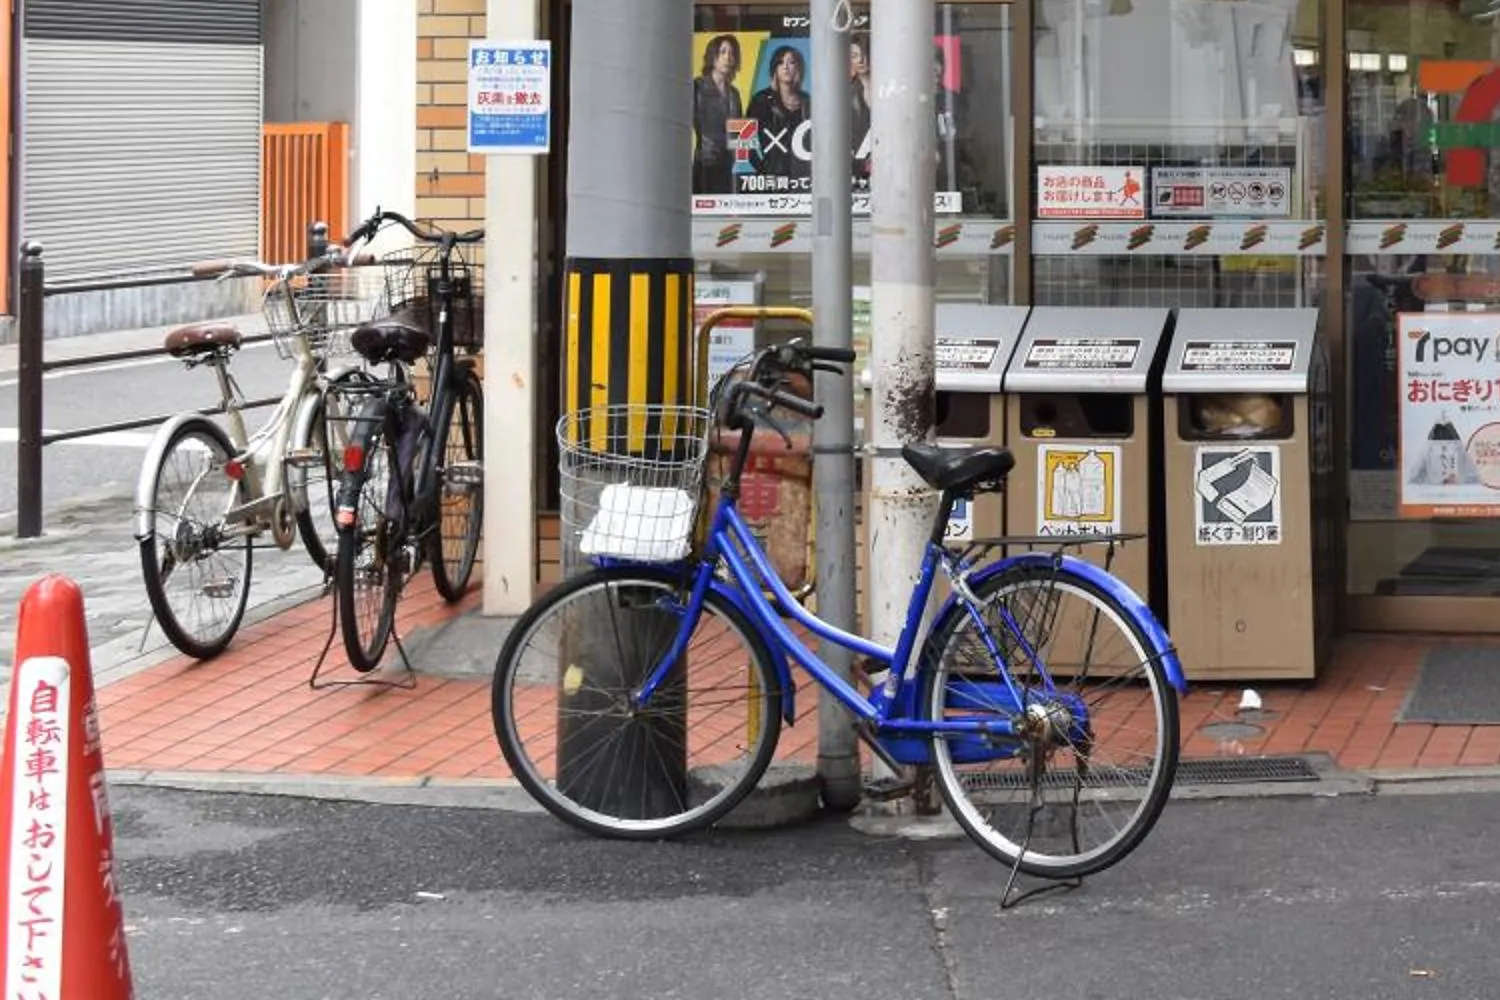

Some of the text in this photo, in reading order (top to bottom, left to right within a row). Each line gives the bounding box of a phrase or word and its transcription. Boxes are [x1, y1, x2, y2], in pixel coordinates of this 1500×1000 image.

[475, 51, 545, 65] お知らせ
[1407, 330, 1490, 363] 7pay
